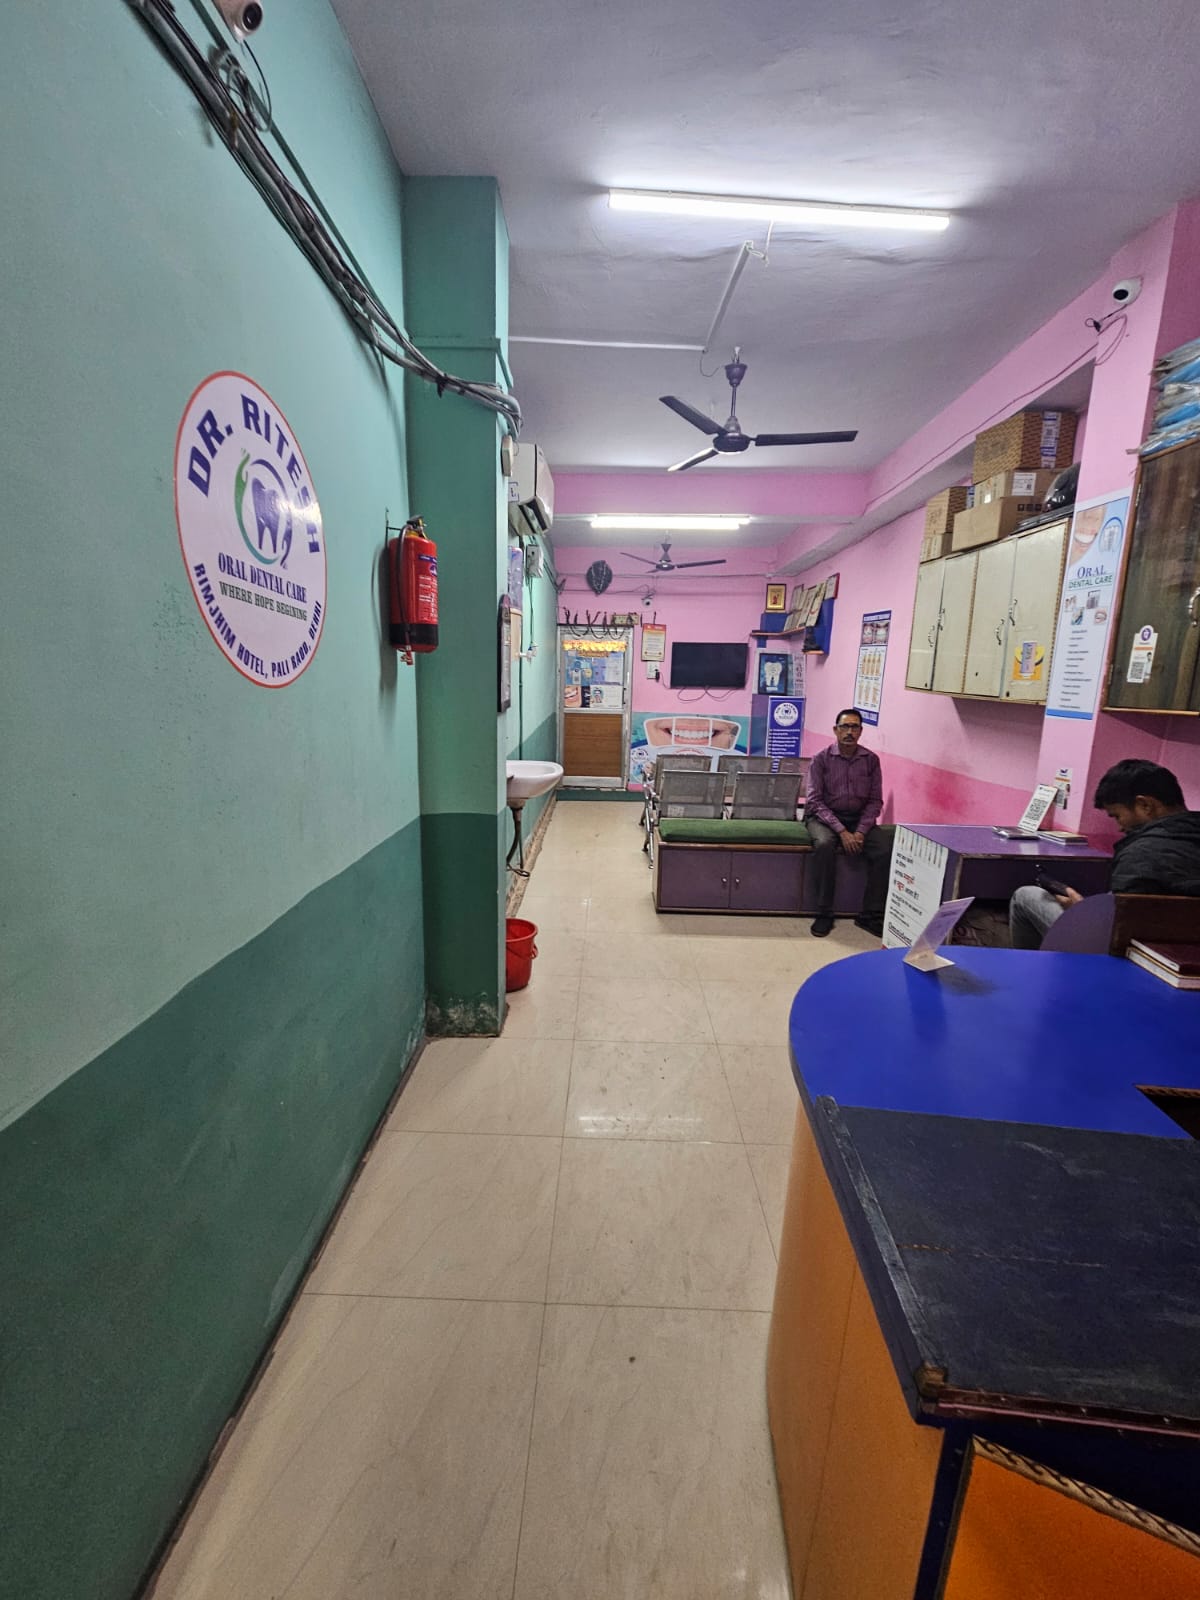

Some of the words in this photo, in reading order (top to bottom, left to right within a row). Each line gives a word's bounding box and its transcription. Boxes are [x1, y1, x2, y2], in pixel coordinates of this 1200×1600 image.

[187, 409, 234, 498] DR.
[218, 552, 248, 582] ORAL
[249, 564, 285, 595] DENTAL
[286, 580, 308, 604] CARE
[1068, 579, 1094, 589] DENTAL
[1094, 574, 1113, 585] CARE
[1077, 565, 1106, 579] ORAL
[193, 562, 237, 649] RIMJHIM
[236, 642, 268, 679] HOTEL,
[271, 658, 291, 679] PALI
[218, 581, 253, 605] WHERE
[254, 592, 275, 612] HOPE
[276, 600, 308, 622] BEGINING
